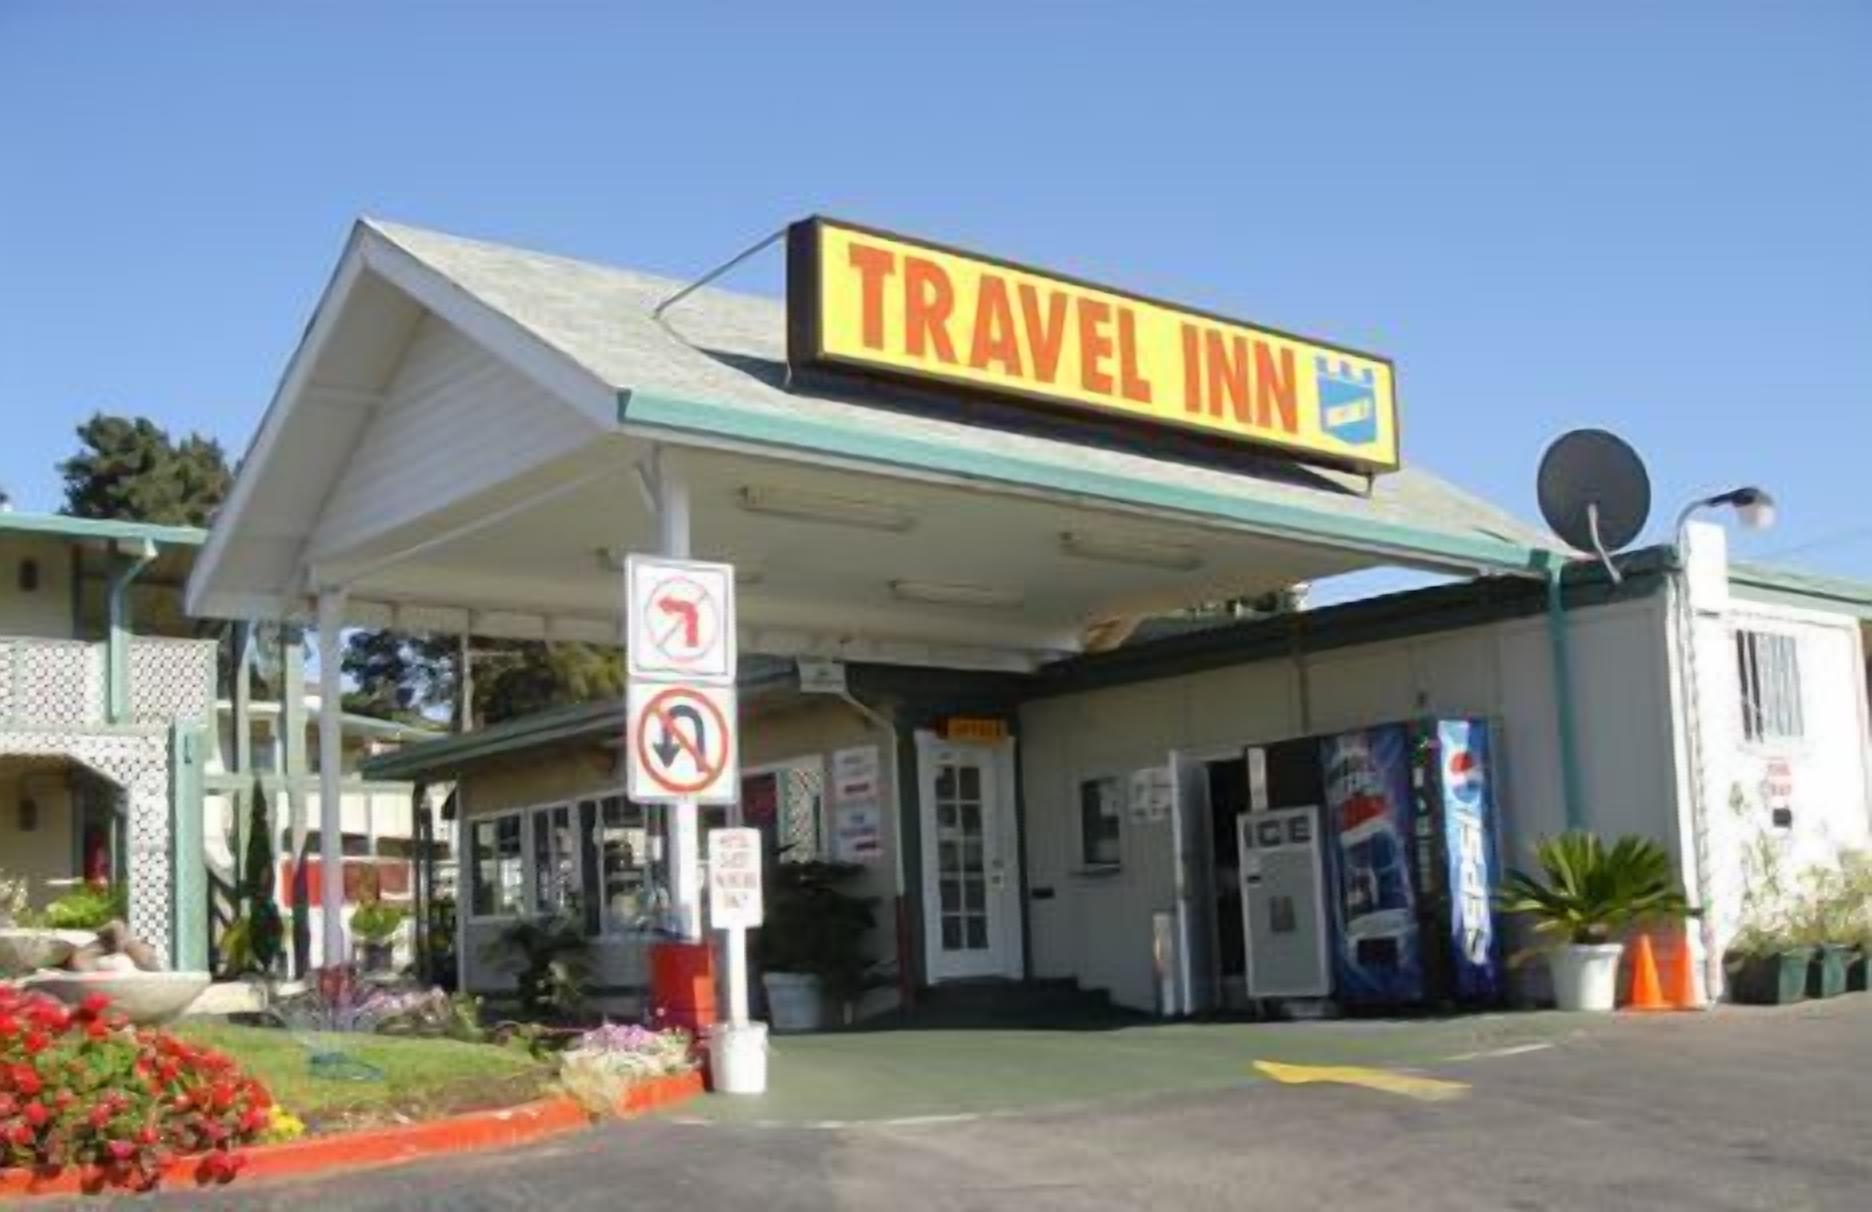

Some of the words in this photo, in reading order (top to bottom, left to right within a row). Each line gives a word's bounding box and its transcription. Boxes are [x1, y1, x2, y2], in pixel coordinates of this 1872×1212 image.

[848, 242, 1152, 403] TRAVEL
[1181, 321, 1299, 434] INN
[1243, 815, 1311, 847] ICE
